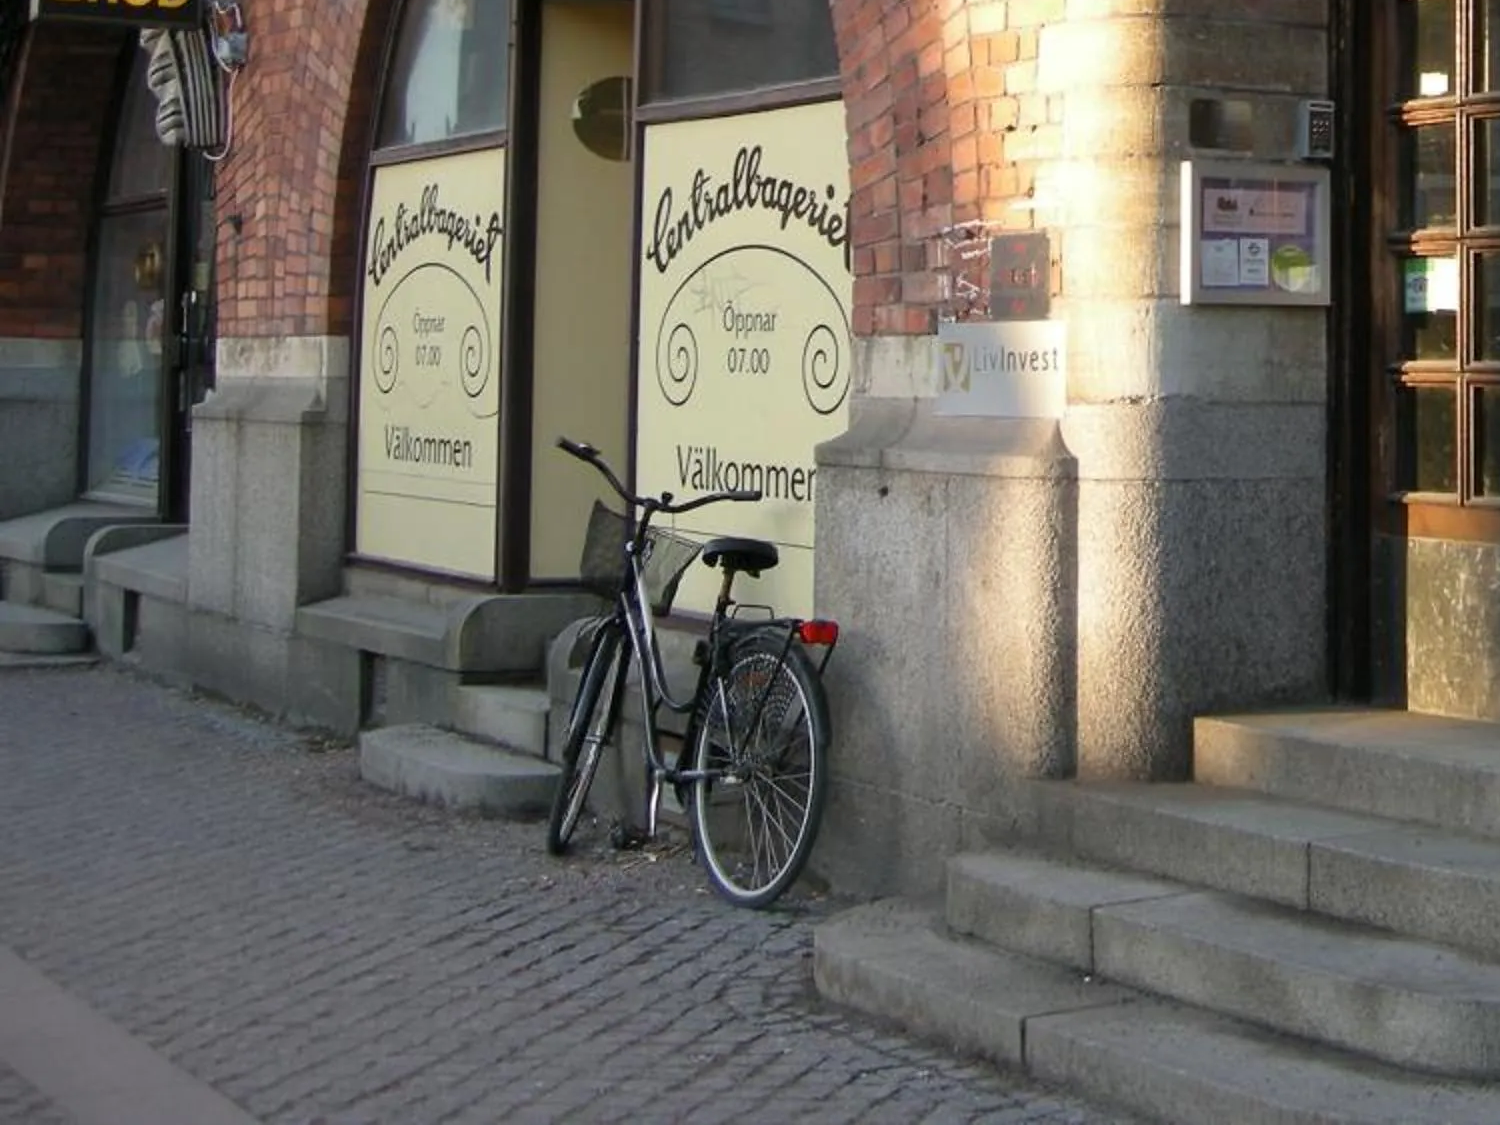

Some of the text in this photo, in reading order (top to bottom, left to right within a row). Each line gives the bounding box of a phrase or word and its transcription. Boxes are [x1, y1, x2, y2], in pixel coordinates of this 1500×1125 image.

[368, 185, 503, 286] Centralbageriet
[723, 300, 777, 340] Öppnar
[727, 346, 770, 374] 07.00
[973, 346, 1058, 371] LivInvest
[384, 424, 472, 469] Välkommen
